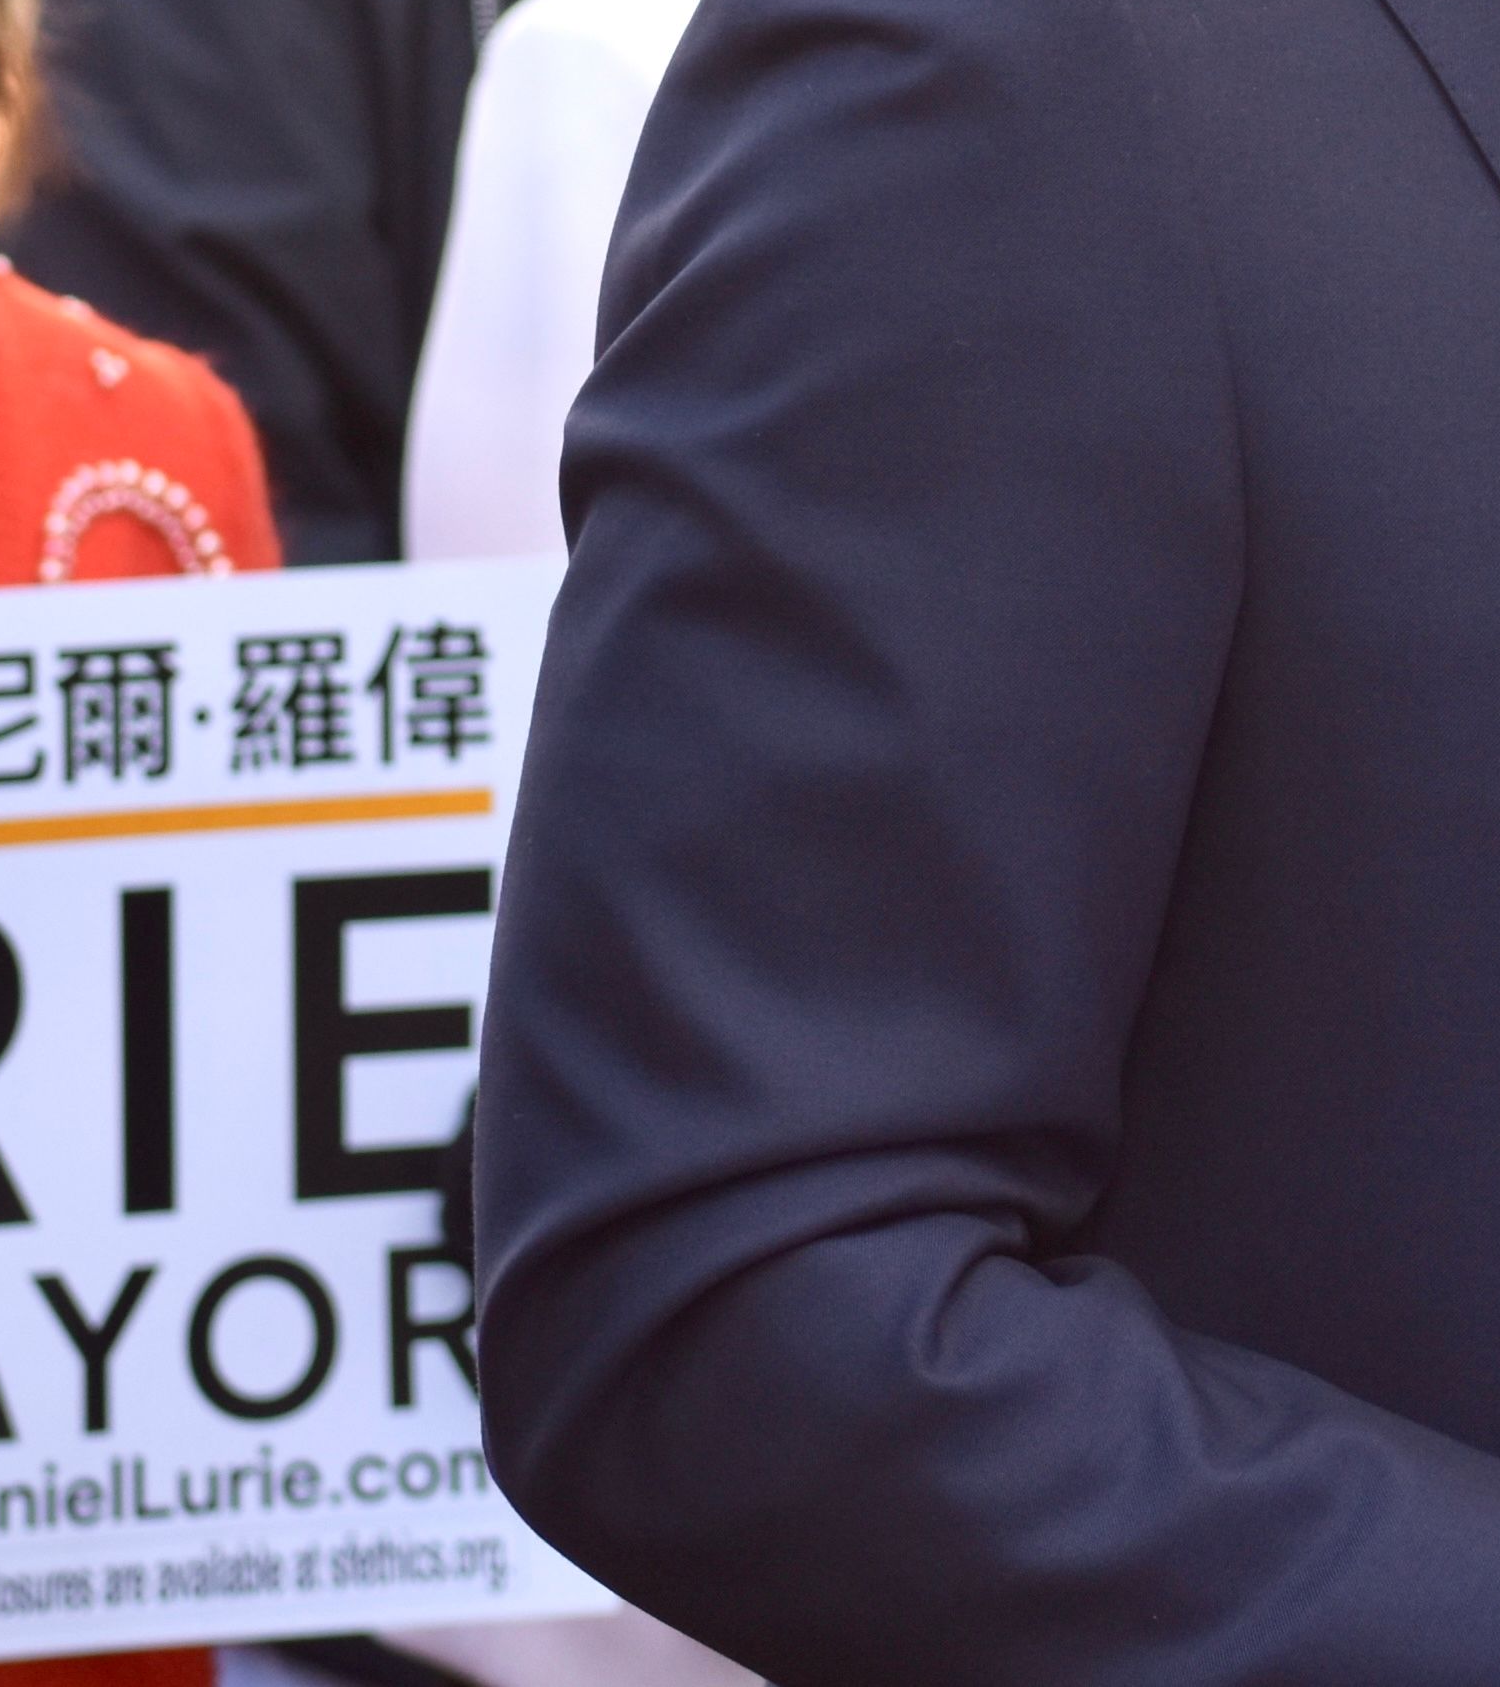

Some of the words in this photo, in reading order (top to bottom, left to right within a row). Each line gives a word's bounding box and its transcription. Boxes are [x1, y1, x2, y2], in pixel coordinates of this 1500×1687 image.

[105, 1562, 145, 1607] are
[158, 1542, 283, 1601] available
[296, 1543, 321, 1591] at
